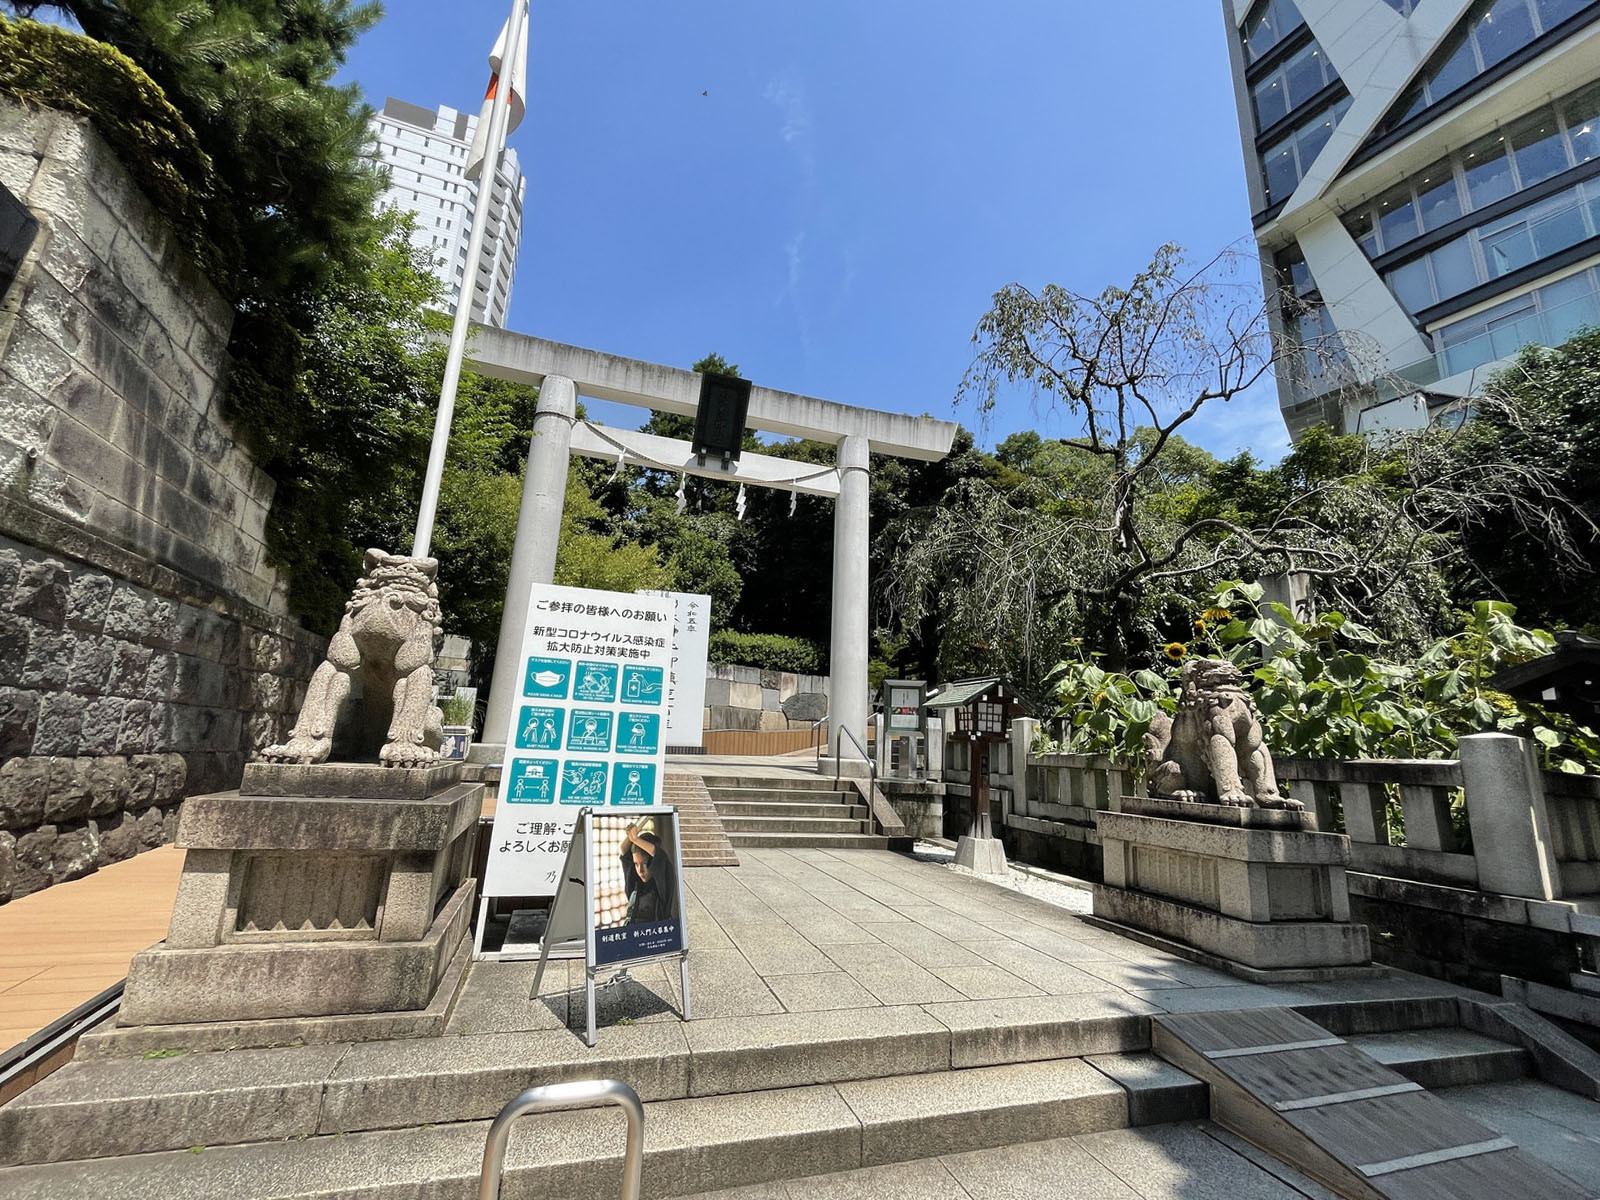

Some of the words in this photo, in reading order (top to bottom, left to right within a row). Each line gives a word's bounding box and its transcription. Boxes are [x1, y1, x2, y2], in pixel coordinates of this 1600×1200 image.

[536, 599, 667, 623] ご参拝の皆様へのお願い
[533, 625, 666, 648] 新型コロナウイルス感染症
[546, 640, 651, 660] 拡大防止対策実施中
